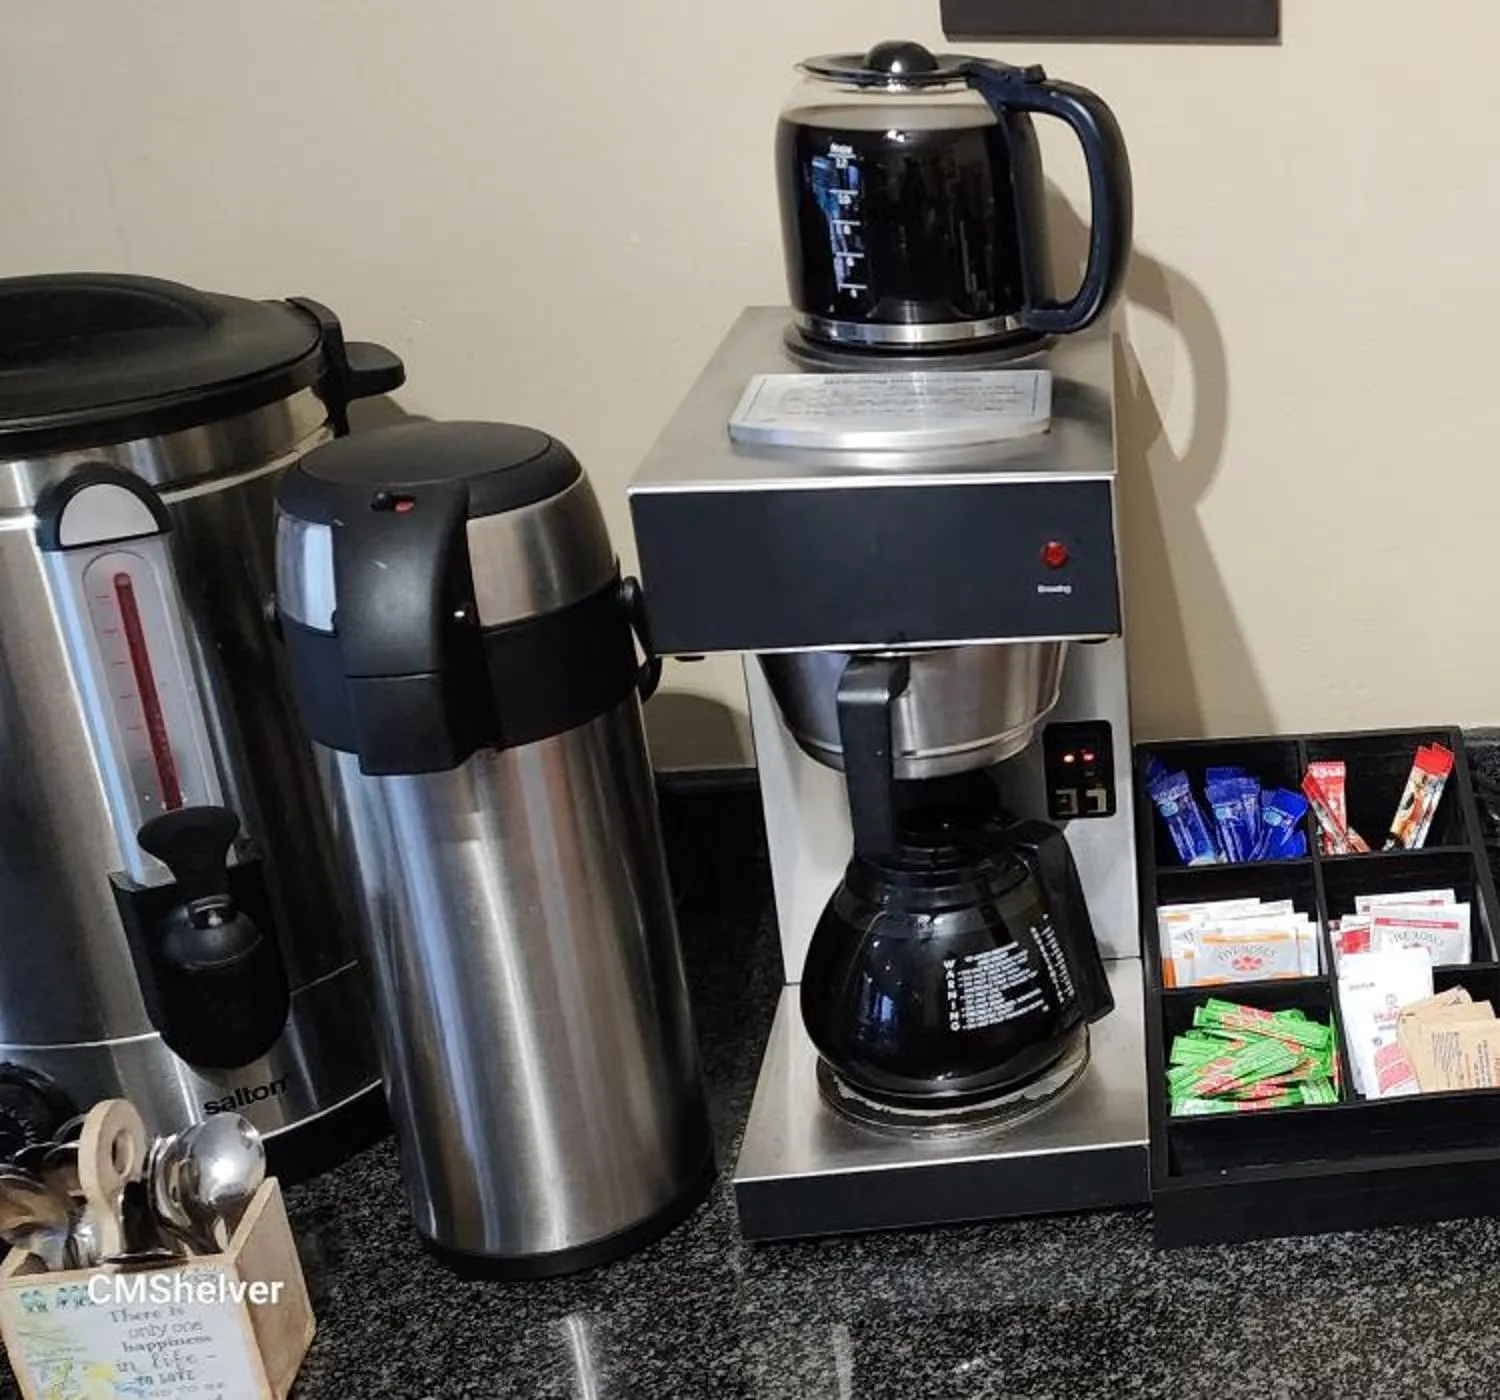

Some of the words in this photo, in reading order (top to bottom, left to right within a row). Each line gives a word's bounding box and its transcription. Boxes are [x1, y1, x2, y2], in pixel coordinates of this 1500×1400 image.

[204, 1080, 286, 1115] salton
[110, 1308, 160, 1322] There
[128, 1323, 168, 1339] only
[171, 1321, 203, 1333] one
